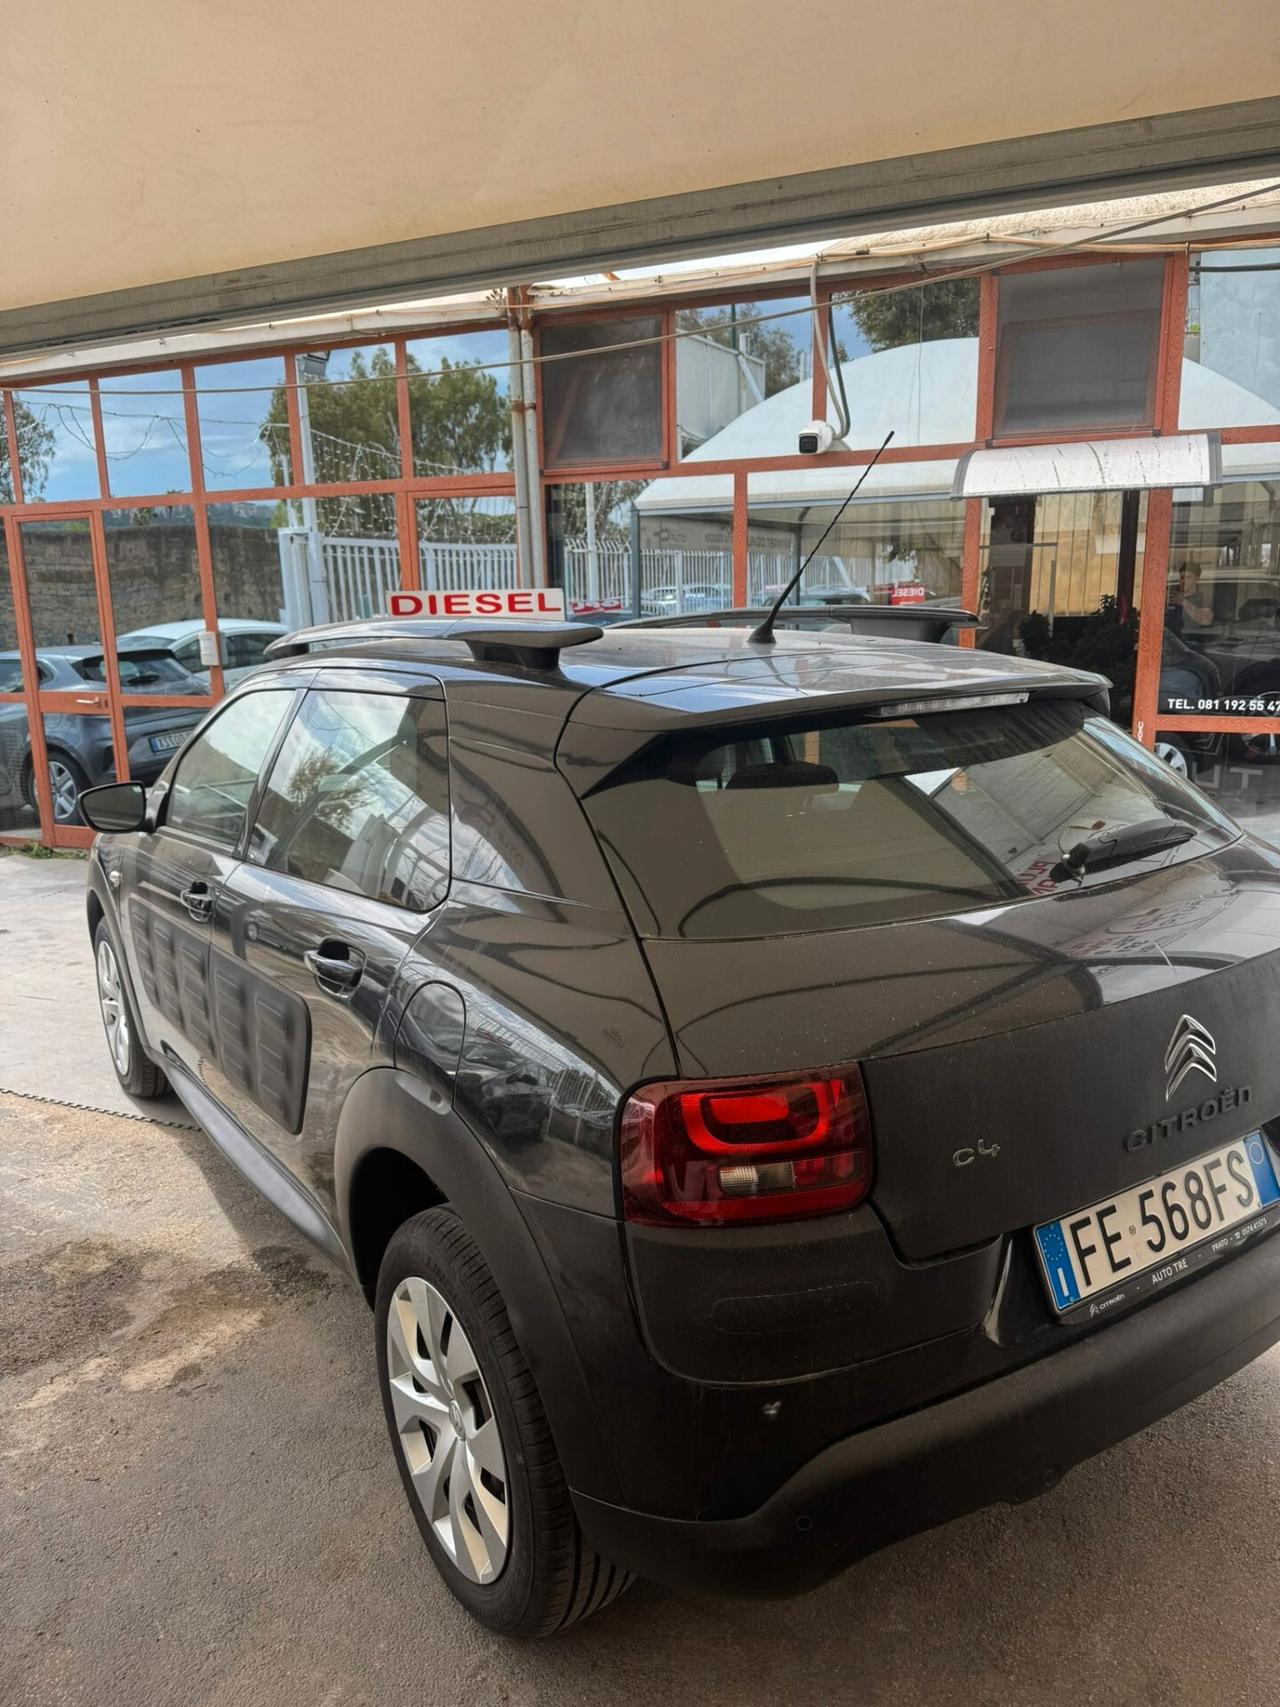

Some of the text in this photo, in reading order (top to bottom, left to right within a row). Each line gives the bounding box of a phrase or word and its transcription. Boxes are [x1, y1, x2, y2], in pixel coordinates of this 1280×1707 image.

[391, 592, 562, 616] DIESEL
[1167, 698, 1195, 710] TEL.
[1198, 699, 1219, 710] 081
[1223, 700, 1246, 711] 192
[1249, 701, 1264, 711] 55
[1151, 1266, 1174, 1285] AUTO
[1174, 1258, 1189, 1272] TRE
